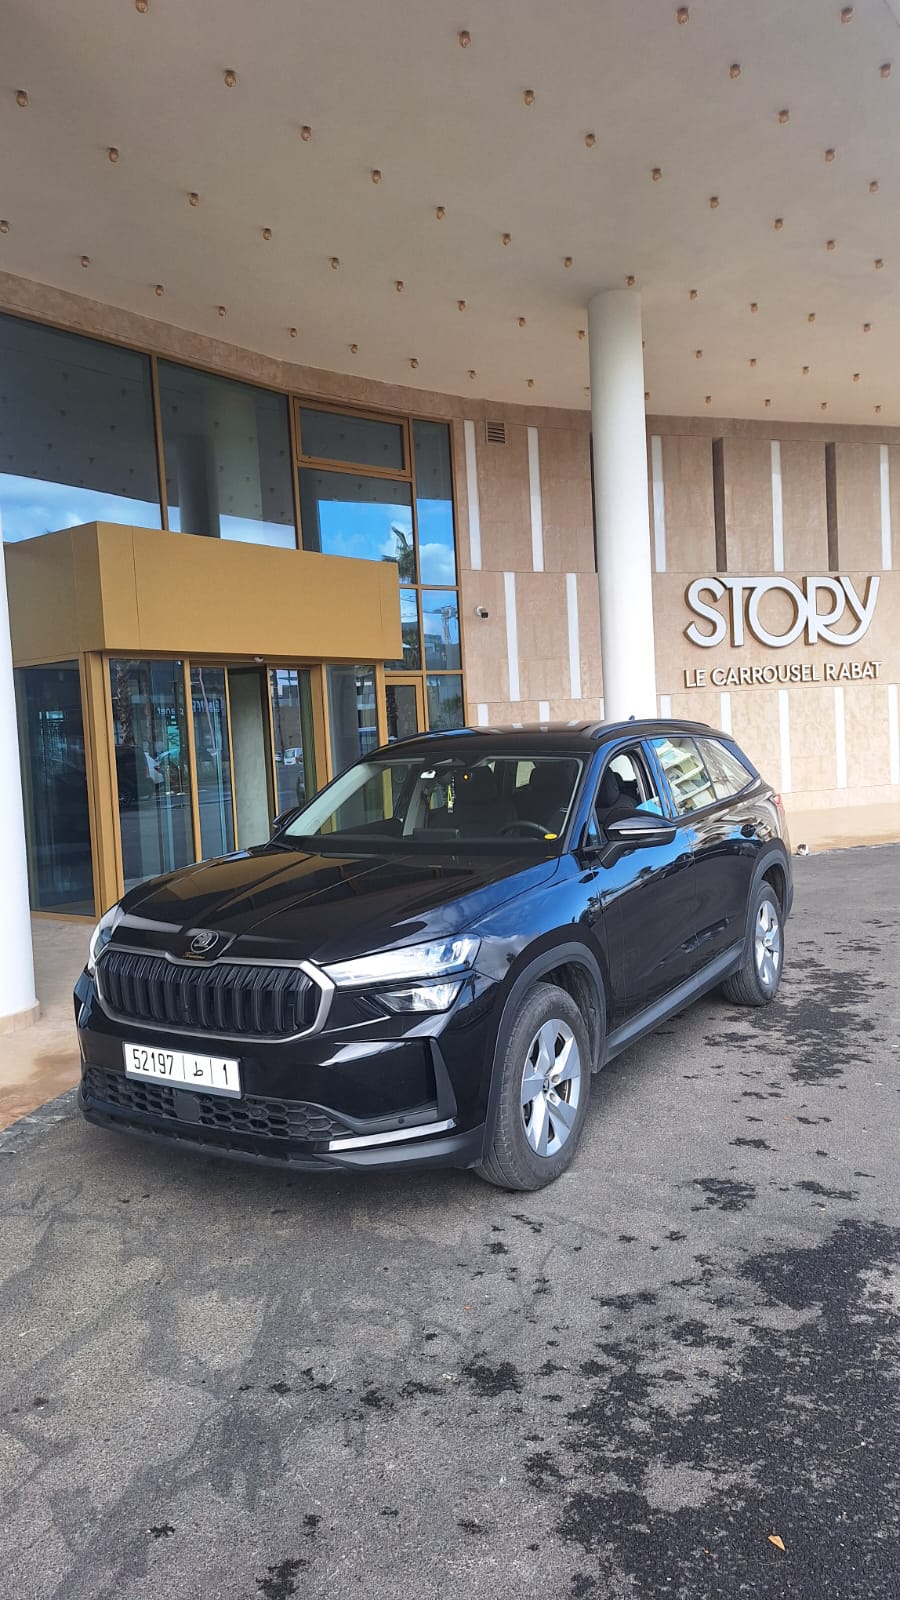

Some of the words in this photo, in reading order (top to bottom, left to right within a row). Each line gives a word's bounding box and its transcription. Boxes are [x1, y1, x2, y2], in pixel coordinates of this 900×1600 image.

[683, 576, 881, 648] STORY
[684, 669, 707, 688] LE
[710, 663, 821, 687] CARROUSEL
[824, 661, 883, 681] RABAT
[132, 1048, 174, 1076] 52197
[192, 1060, 204, 1077] ط
[222, 1063, 229, 1085] 1
